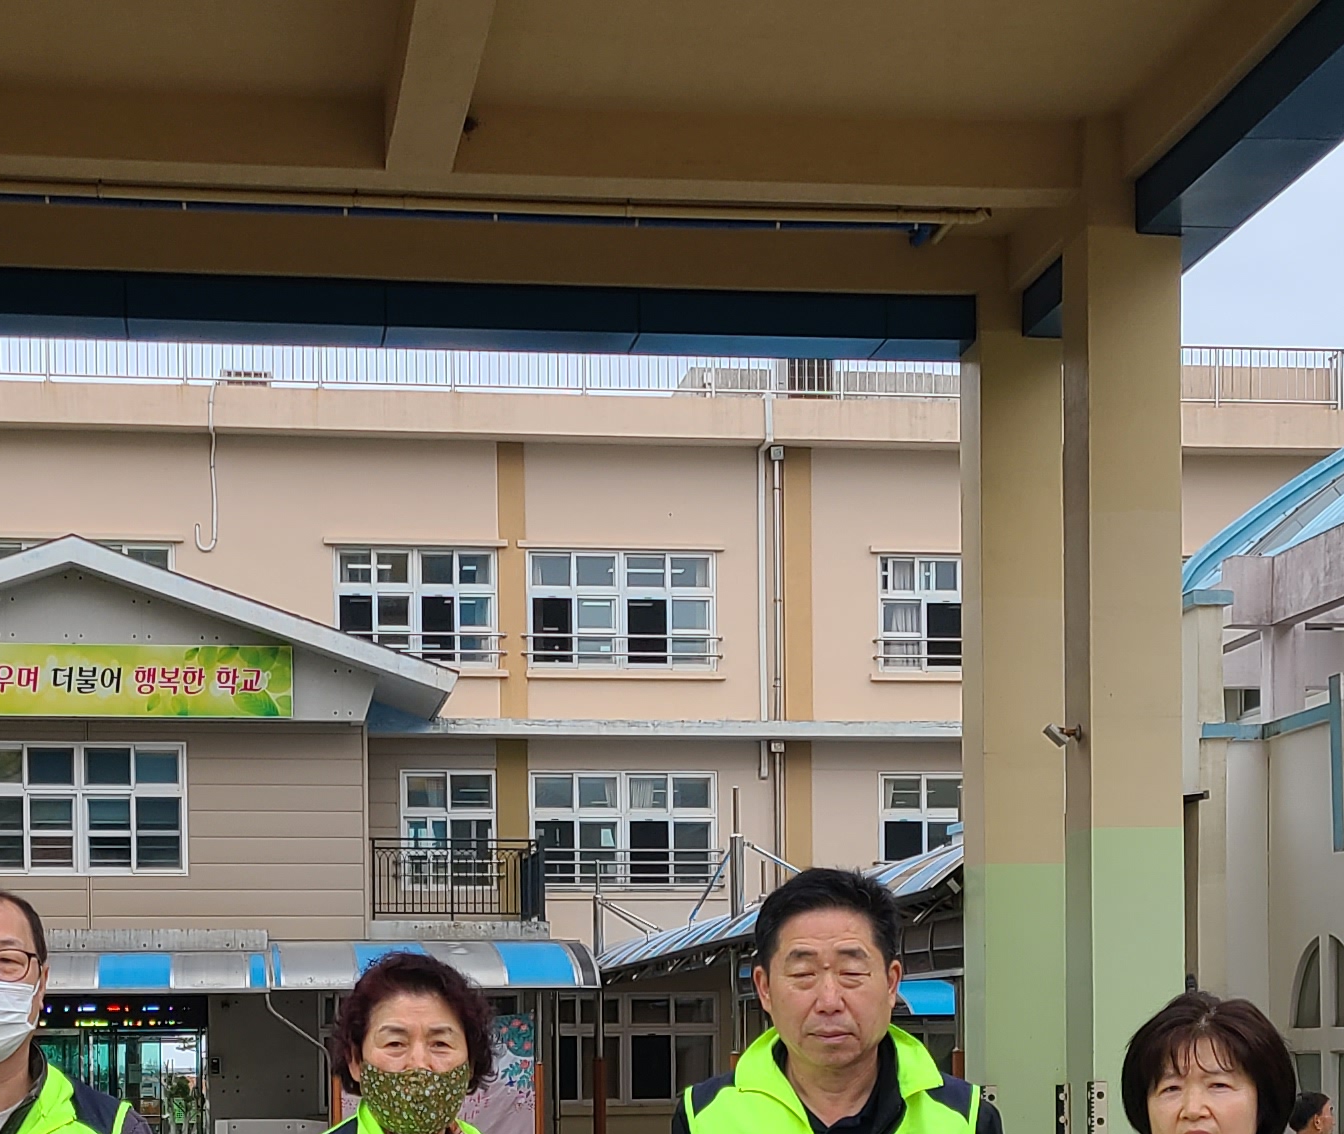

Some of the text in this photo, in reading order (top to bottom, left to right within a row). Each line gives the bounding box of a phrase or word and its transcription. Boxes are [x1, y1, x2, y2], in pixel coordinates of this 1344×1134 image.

[51, 664, 123, 694] 더불어
[133, 663, 206, 695] 행복한
[216, 665, 263, 696] 학교
